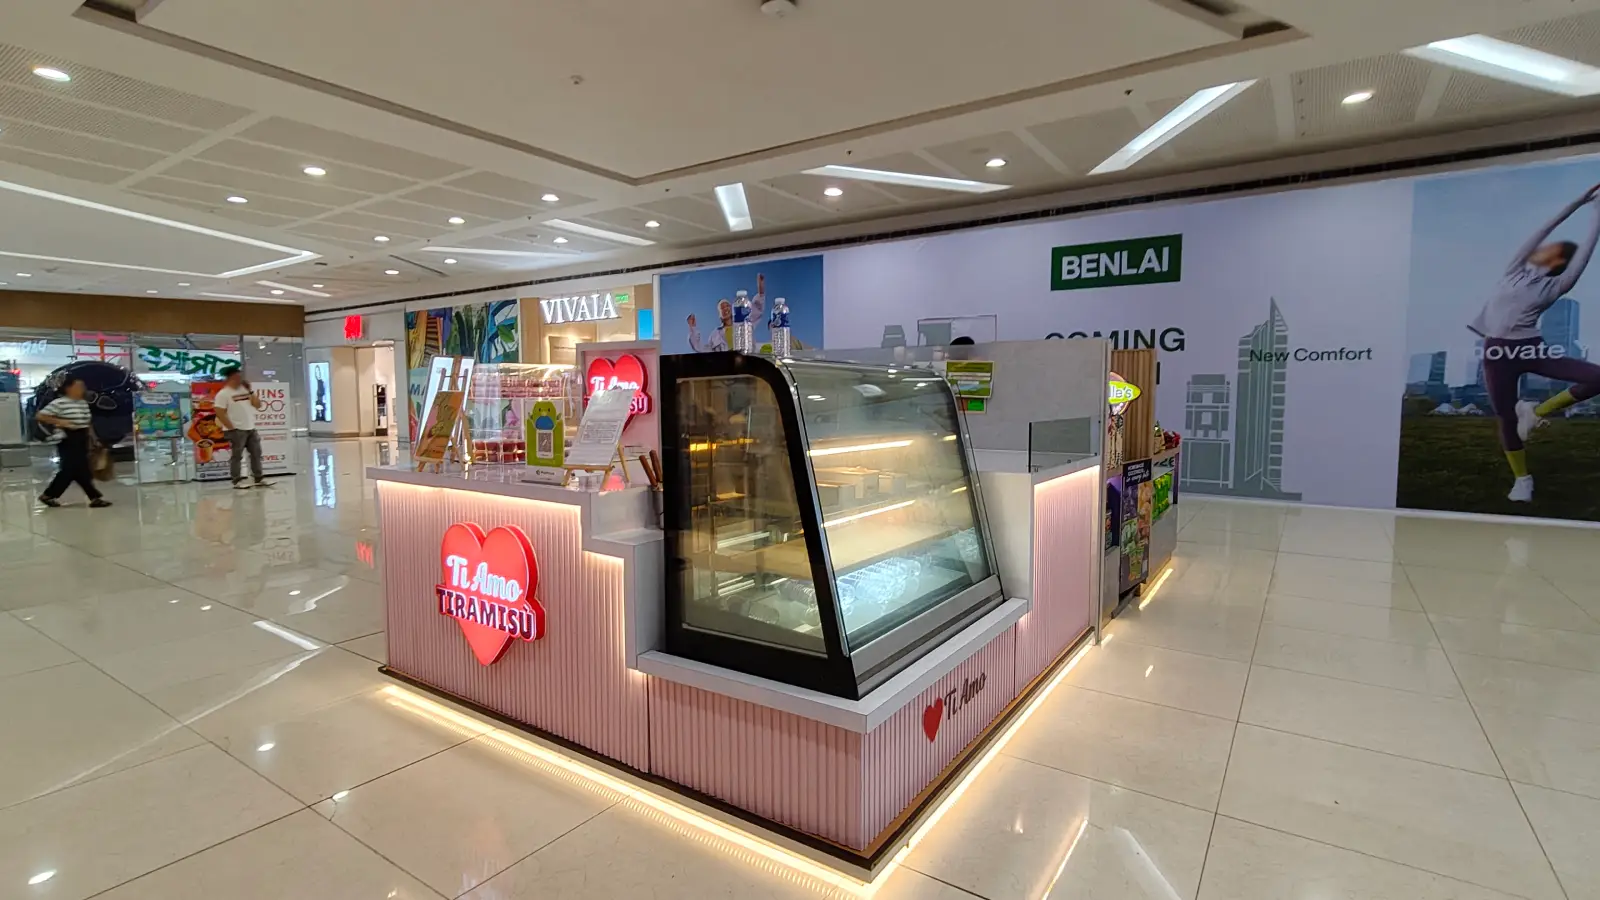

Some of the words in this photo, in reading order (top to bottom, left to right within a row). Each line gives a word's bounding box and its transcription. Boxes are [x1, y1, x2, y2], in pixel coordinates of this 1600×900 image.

[1061, 246, 1170, 281] BENLAI
[540, 293, 619, 324] VIVAIA
[1249, 348, 1290, 363] New
[1293, 347, 1373, 362] Comfort
[446, 555, 470, 588] Ti
[470, 562, 523, 602] Amo
[436, 587, 535, 640] TIRAMISÙ
[944, 687, 957, 720] Ti
[959, 672, 987, 710] Amo
